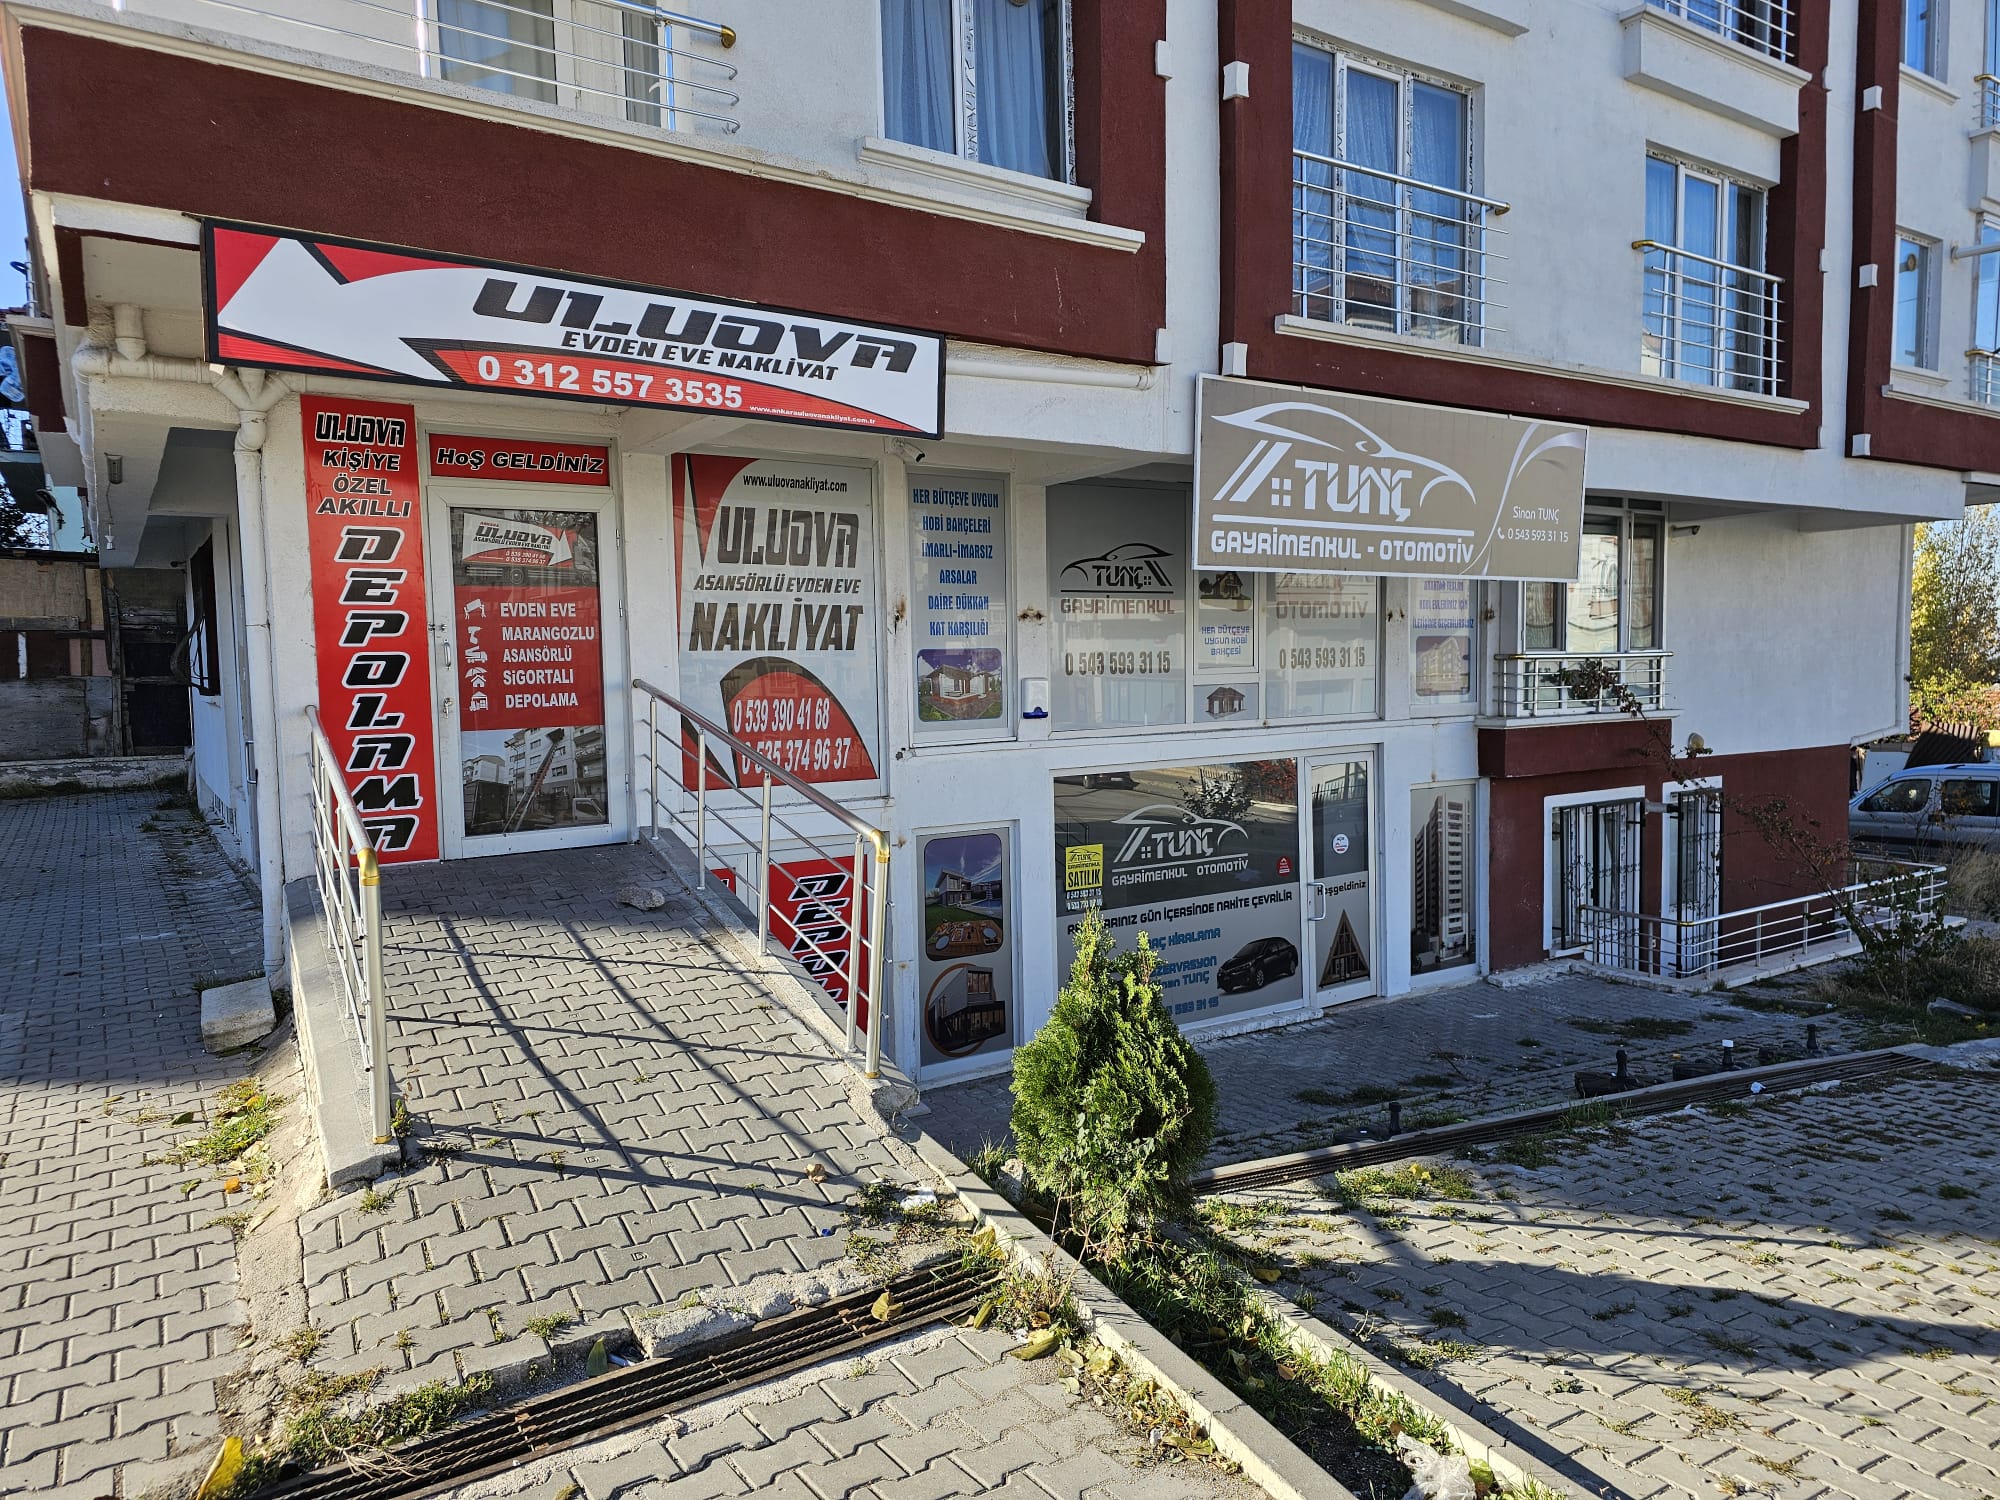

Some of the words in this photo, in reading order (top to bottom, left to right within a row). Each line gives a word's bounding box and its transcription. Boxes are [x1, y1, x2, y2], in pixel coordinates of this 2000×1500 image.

[472, 277, 918, 374] ULUOVA
[561, 330, 657, 359] EVDEN
[661, 344, 713, 366] EVE
[717, 351, 838, 381] NAKLİYAT
[478, 356, 500, 381] 0
[513, 359, 580, 391] 312
[592, 368, 654, 398] 557
[665, 377, 743, 408] 3535
[315, 411, 407, 448] ULUOVA
[322, 446, 400, 472] KİŞİYE
[492, 451, 606, 475] GELDİNİZ
[332, 473, 392, 496] ÖZEL
[743, 474, 848, 493] www.uluovanakliyat.com
[1295, 459, 1412, 522] TUNÇ
[315, 497, 412, 519] AKILLI
[913, 488, 930, 504] HER
[932, 487, 969, 508] BÜTÇEYE
[971, 492, 999, 508] UYGUN
[922, 513, 944, 531] HOBİ
[946, 516, 991, 535] BAHÇELERİ
[1513, 505, 1536, 520] Sinan
[1538, 507, 1560, 525] TUNÇ
[475, 526, 552, 544] ULUOVA
[717, 505, 859, 569] ULUOVA
[1211, 527, 1361, 560] GAYRİMENKUL
[1379, 537, 1474, 563] OTOMOTİV
[1507, 528, 1514, 540] 0
[1515, 528, 1530, 541] 543
[1531, 529, 1546, 542] 593
[1547, 530, 1556, 542] 31
[1560, 531, 1569, 543] 15
[922, 539, 993, 559] İMARLI-İMARSIZ
[693, 572, 786, 592] ASANSÖRLÜ
[786, 577, 833, 594] EVDEN
[834, 579, 861, 594] EVE
[939, 568, 977, 585] ARSALAR
[1092, 565, 1143, 590] TUNÇ
[500, 602, 546, 617] EVDEN
[550, 602, 576, 617] EVE
[928, 592, 953, 610] DAİRE
[955, 592, 989, 610] DÜKKAN
[1060, 595, 1175, 615] GAYRİMENKUL
[1276, 596, 1368, 619] OTOMOTİV
[502, 626, 595, 641] MARANGOZLU
[688, 597, 864, 651] NAKLİYAT
[929, 621, 945, 636] KAT
[947, 618, 989, 638] KARŞILIĞI
[1201, 626, 1216, 634] HER
[1204, 637, 1230, 645] UYGUN
[1210, 645, 1241, 657] BAHÇESİ
[503, 644, 573, 663] ASANSÖRLÜ
[1065, 652, 1074, 676] 0
[1079, 651, 1105, 675] 543
[1109, 651, 1135, 675] 593
[1139, 651, 1153, 674] 31
[1157, 651, 1170, 674] 15
[1280, 648, 1287, 670] 0
[1291, 648, 1312, 669] 543
[1316, 647, 1336, 669] 593
[1340, 647, 1351, 668] 31
[1354, 647, 1365, 668] 15
[333, 525, 423, 853] DEPOLAMA
[505, 692, 579, 709] DEPOLAMA
[733, 699, 742, 733] 0
[745, 699, 768, 733] 539
[771, 698, 794, 732] 390
[796, 698, 811, 730] 41
[815, 697, 830, 730] 68
[785, 739, 810, 772] 374
[814, 738, 830, 771] 96
[834, 737, 851, 769] 37
[1152, 828, 1214, 858] TUNÇ
[1068, 869, 1101, 888] SATILIK
[1112, 867, 1188, 887] GAYRİMENKUL
[1197, 857, 1249, 876] OTOMOTİV
[1140, 910, 1161, 923] GÜN
[1164, 902, 1215, 921] İÇERSİNDE
[1252, 889, 1292, 909] ÇEVRİLİR
[1182, 970, 1210, 985] TUNÇ
